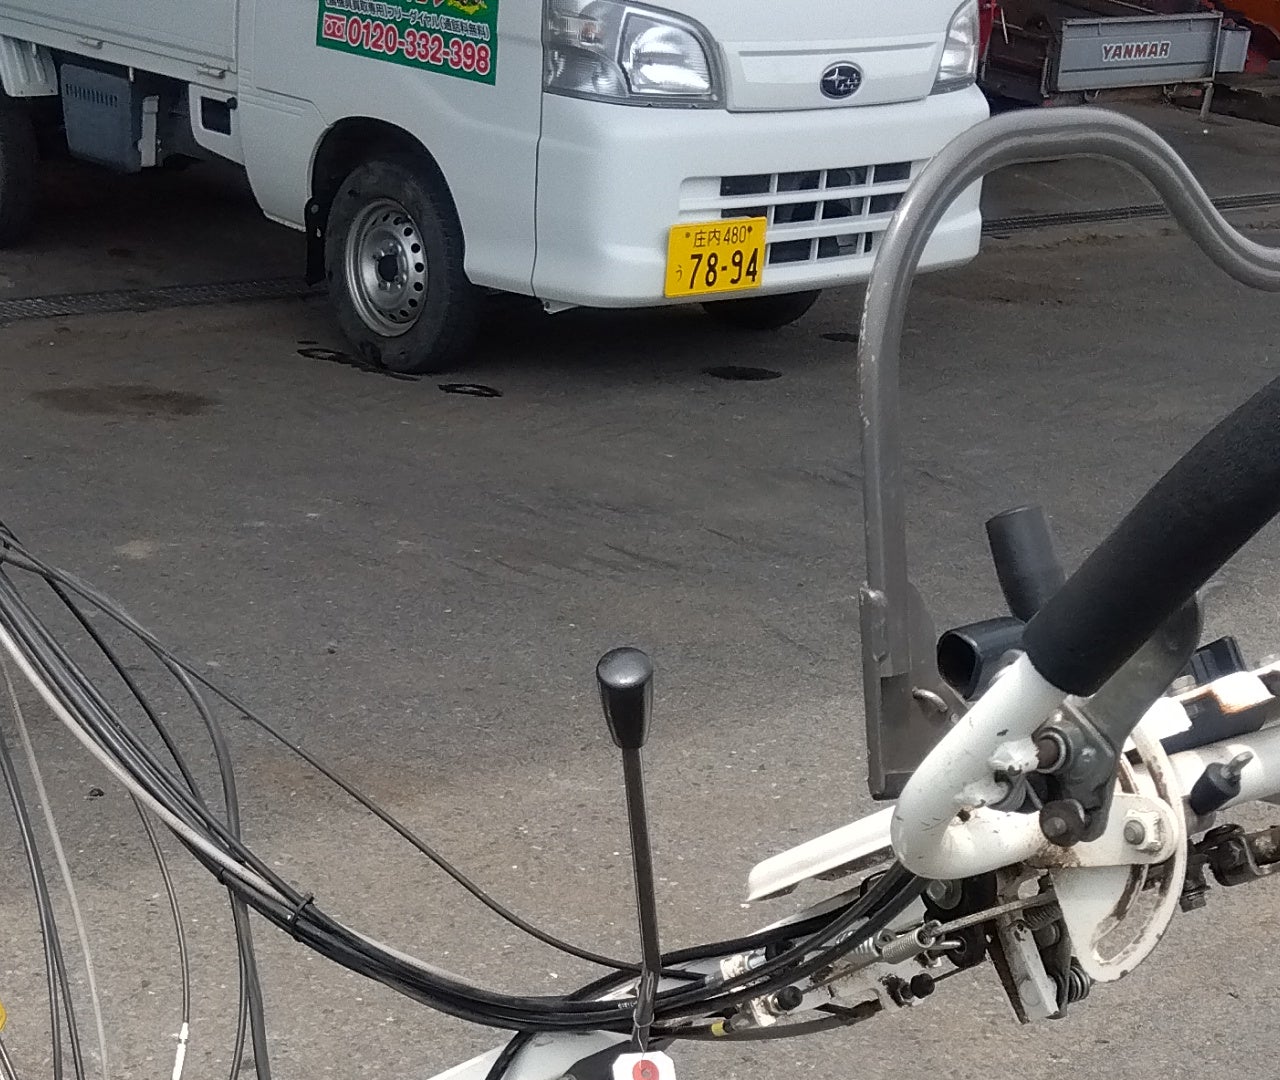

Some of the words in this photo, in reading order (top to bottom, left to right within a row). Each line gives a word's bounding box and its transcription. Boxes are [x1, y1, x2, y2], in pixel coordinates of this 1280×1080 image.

[347, 17, 490, 75] 0120-332-398
[1102, 41, 1171, 61] YANMAR
[694, 229, 720, 248] 庄内
[723, 225, 746, 245] 480
[689, 247, 758, 289] 78-94
